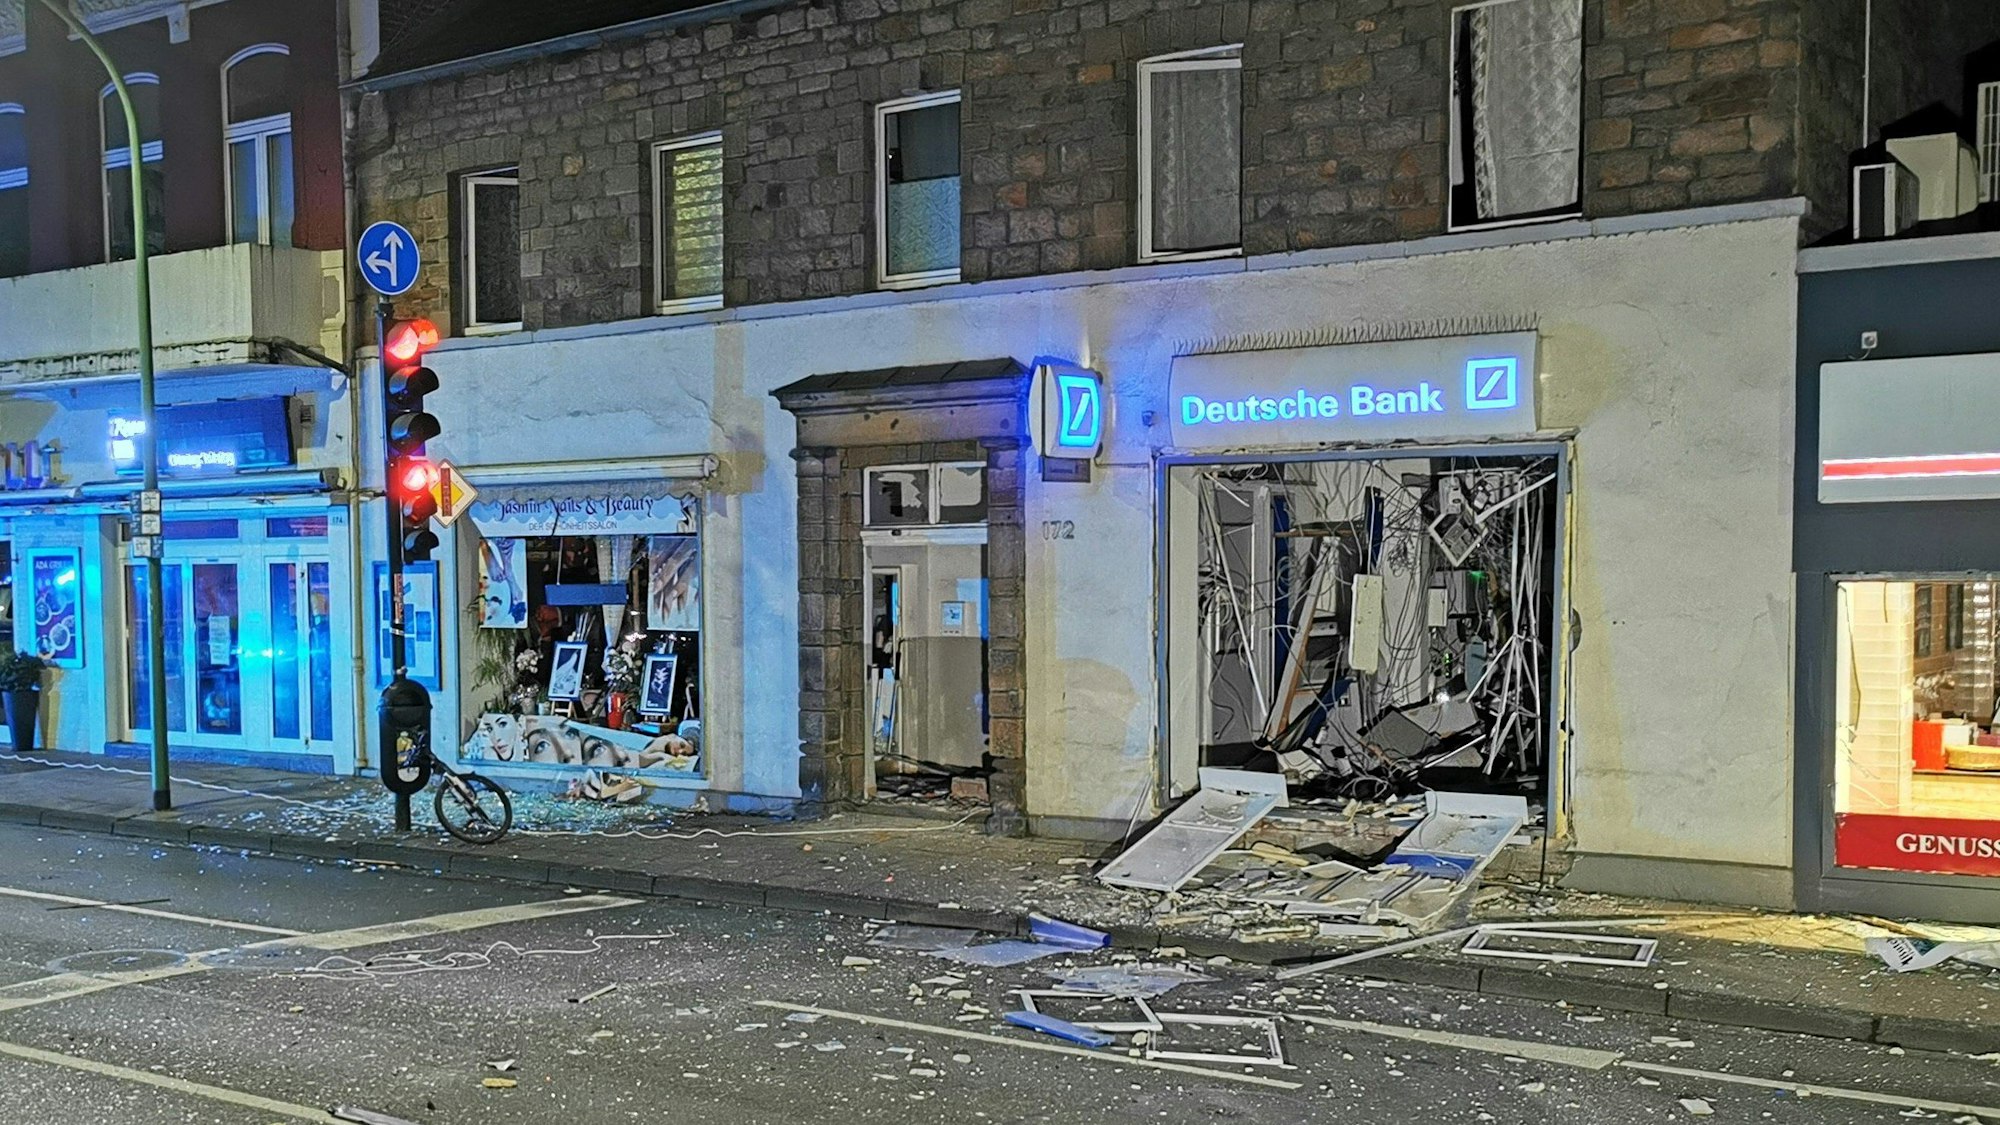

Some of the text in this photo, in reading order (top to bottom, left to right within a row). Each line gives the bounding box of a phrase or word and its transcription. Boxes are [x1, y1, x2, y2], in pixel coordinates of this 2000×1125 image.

[1181, 382, 1443, 426] Deutsche Bank
[495, 497, 541, 522] Jasmin
[585, 496, 597, 515] &
[601, 495, 654, 518] Beauty
[529, 522, 545, 531] DER
[1042, 520, 1075, 540] 172
